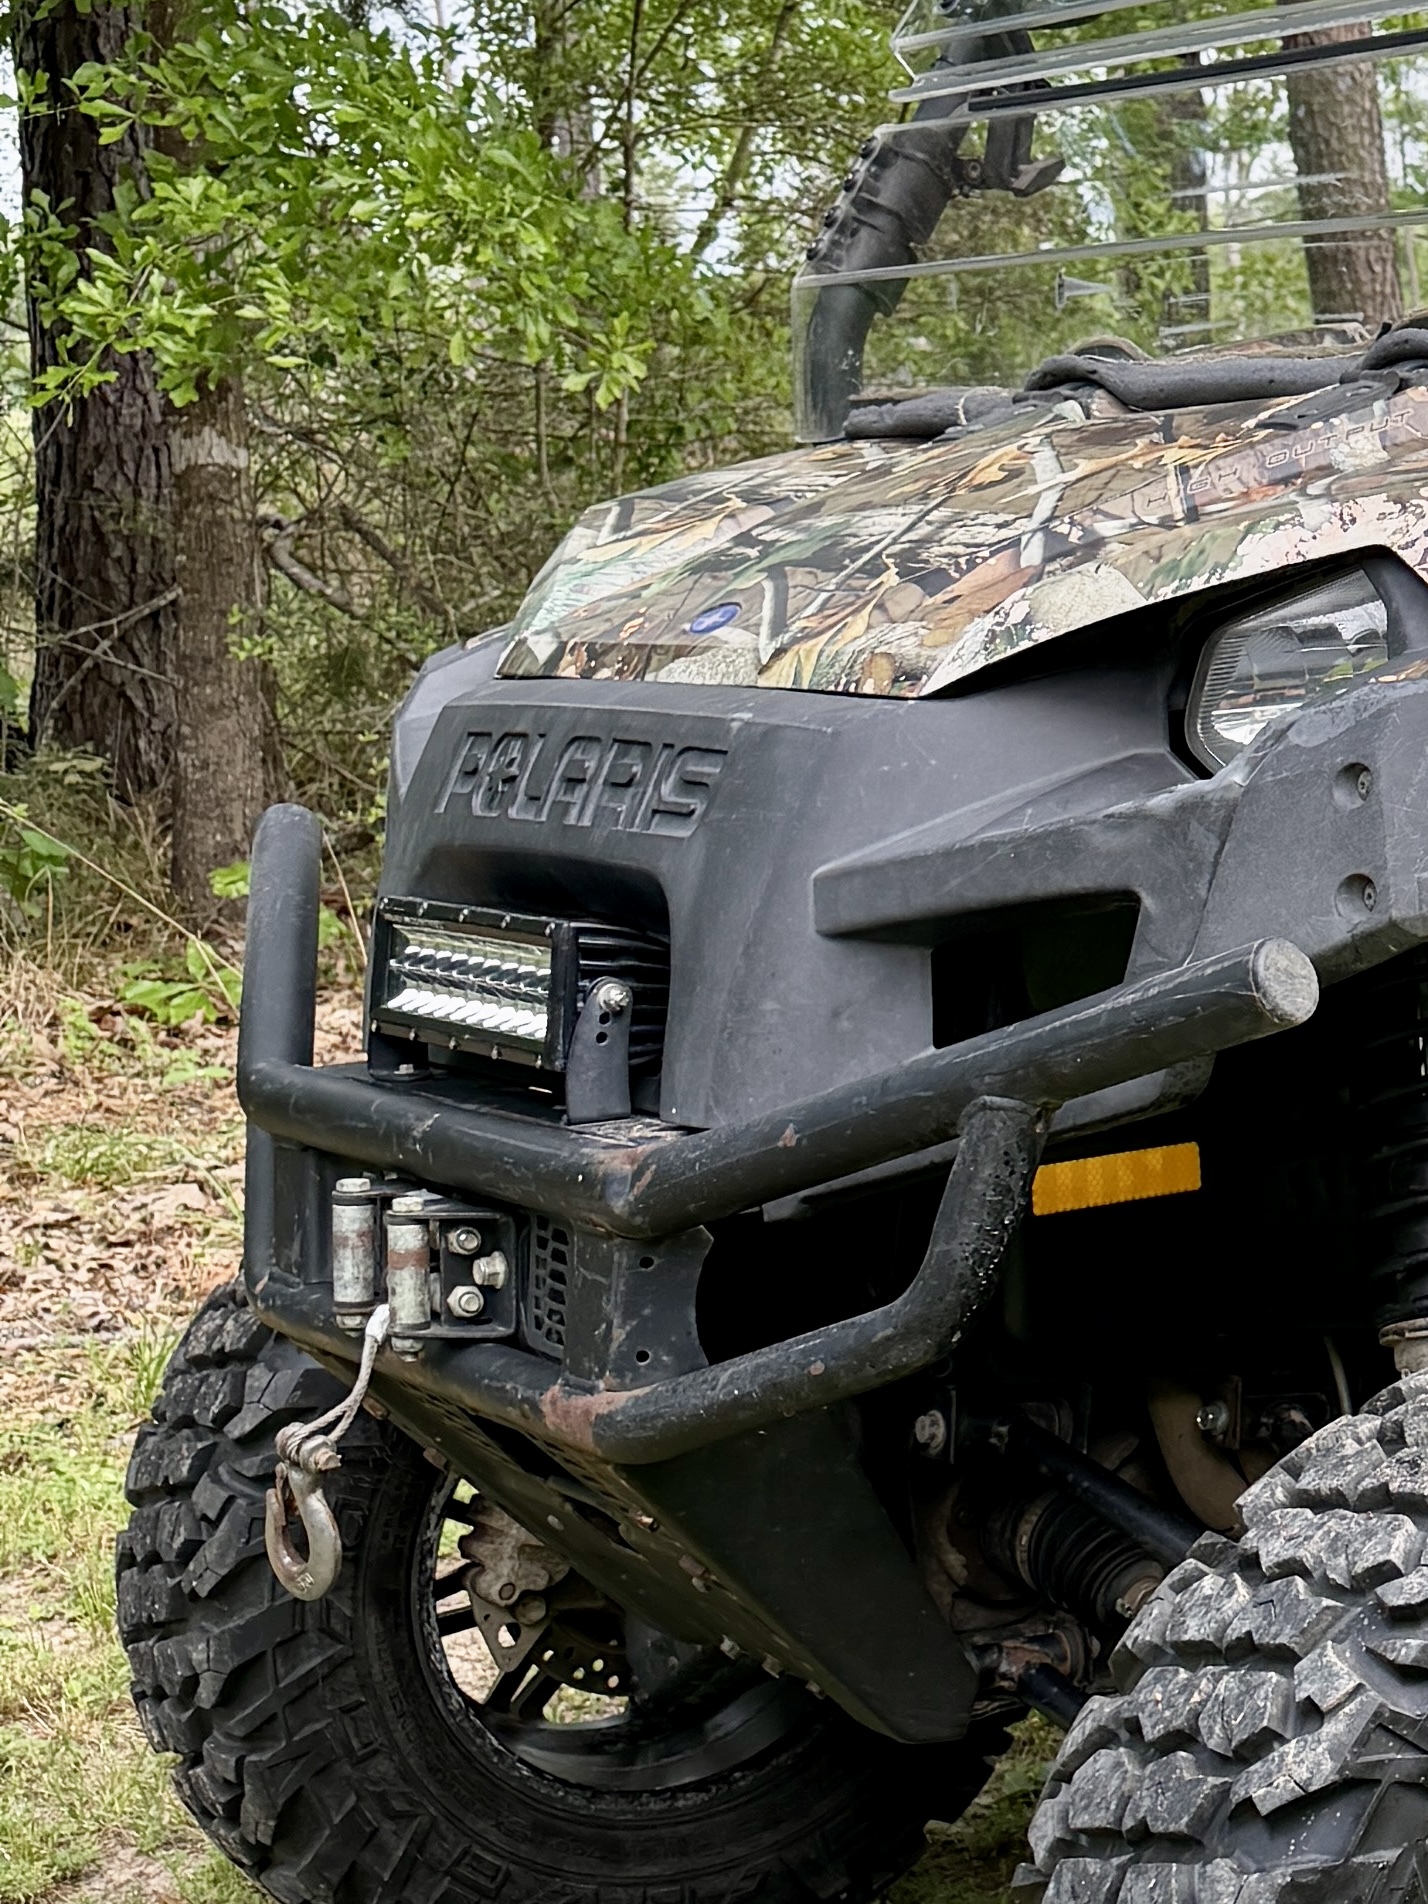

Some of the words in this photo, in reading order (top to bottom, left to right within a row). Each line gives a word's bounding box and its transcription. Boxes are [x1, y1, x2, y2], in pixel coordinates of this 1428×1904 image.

[1145, 465, 1240, 508] HGH
[1264, 408, 1412, 468] OUTPUT
[433, 731, 729, 838] POLARIS
